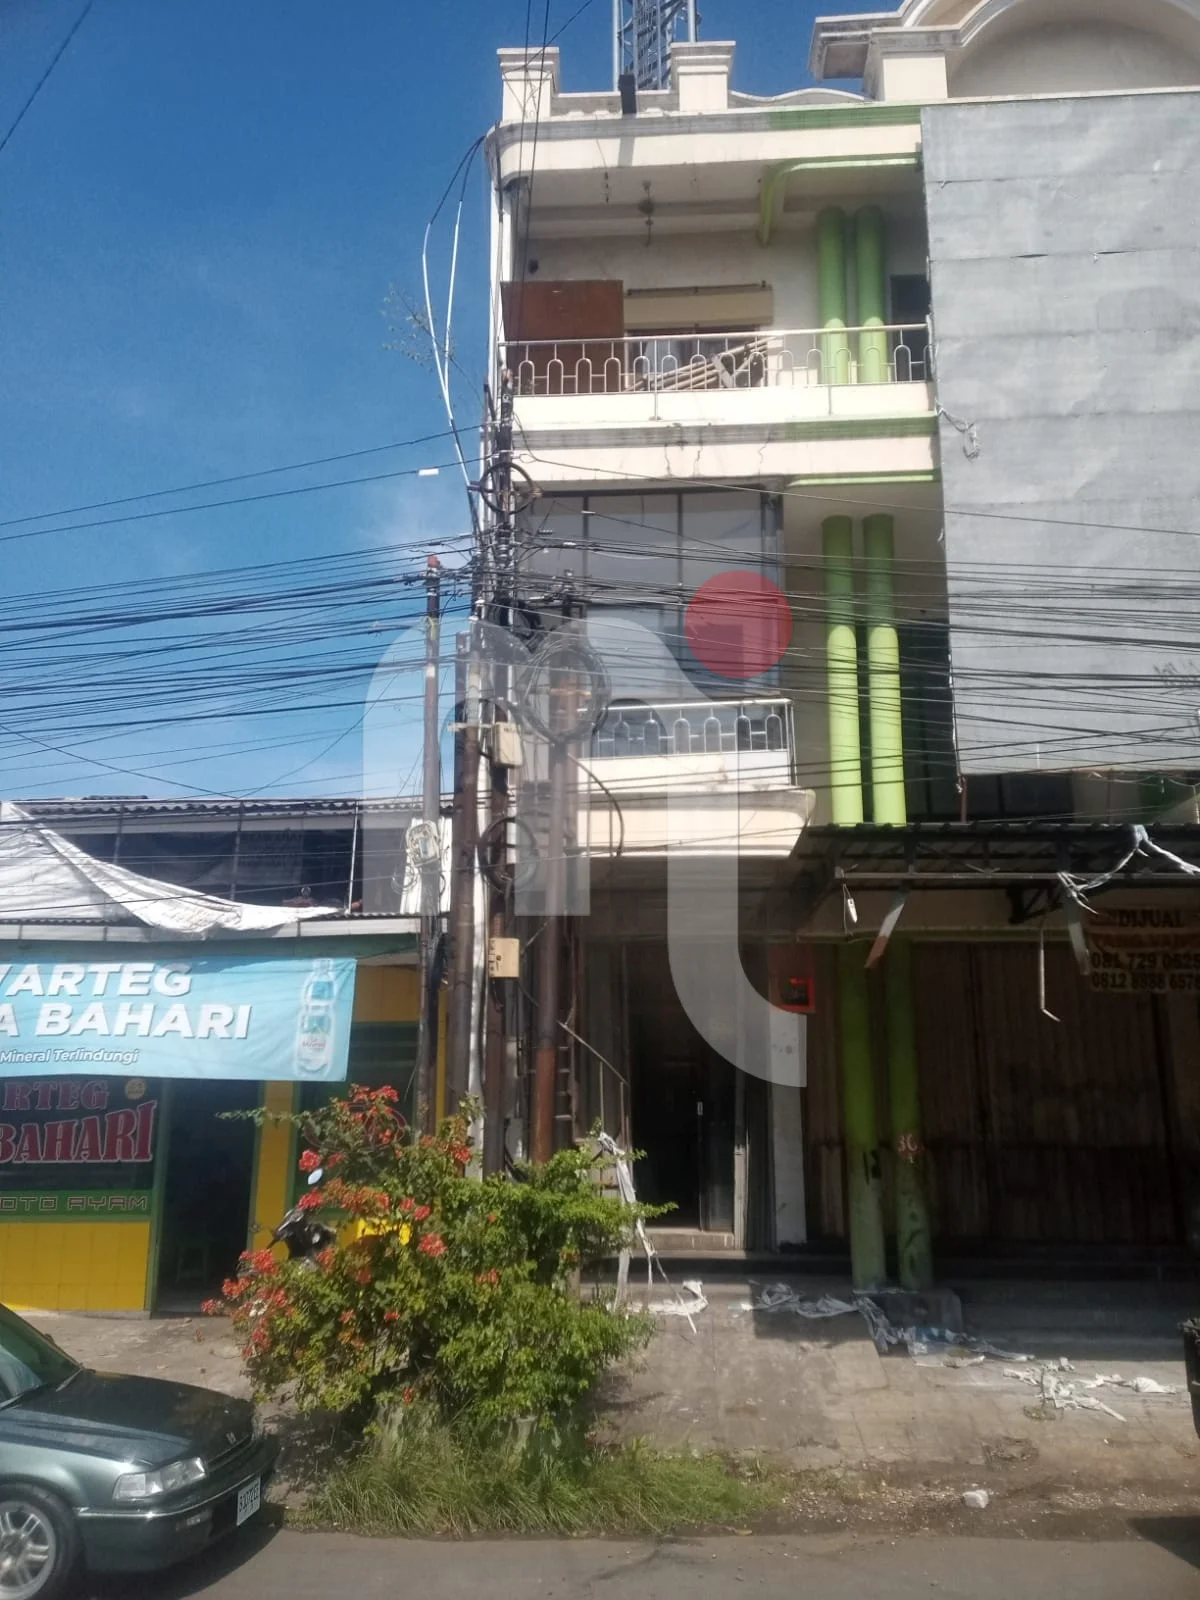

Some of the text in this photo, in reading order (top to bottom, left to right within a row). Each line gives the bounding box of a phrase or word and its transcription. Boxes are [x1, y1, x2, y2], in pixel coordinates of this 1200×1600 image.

[1119, 909, 1184, 928] DIJUAL
[35, 1002, 253, 1040] BAHARI
[0, 1047, 140, 1065] Mineral Terlindungi
[66, 1196, 149, 1211] AYAM
